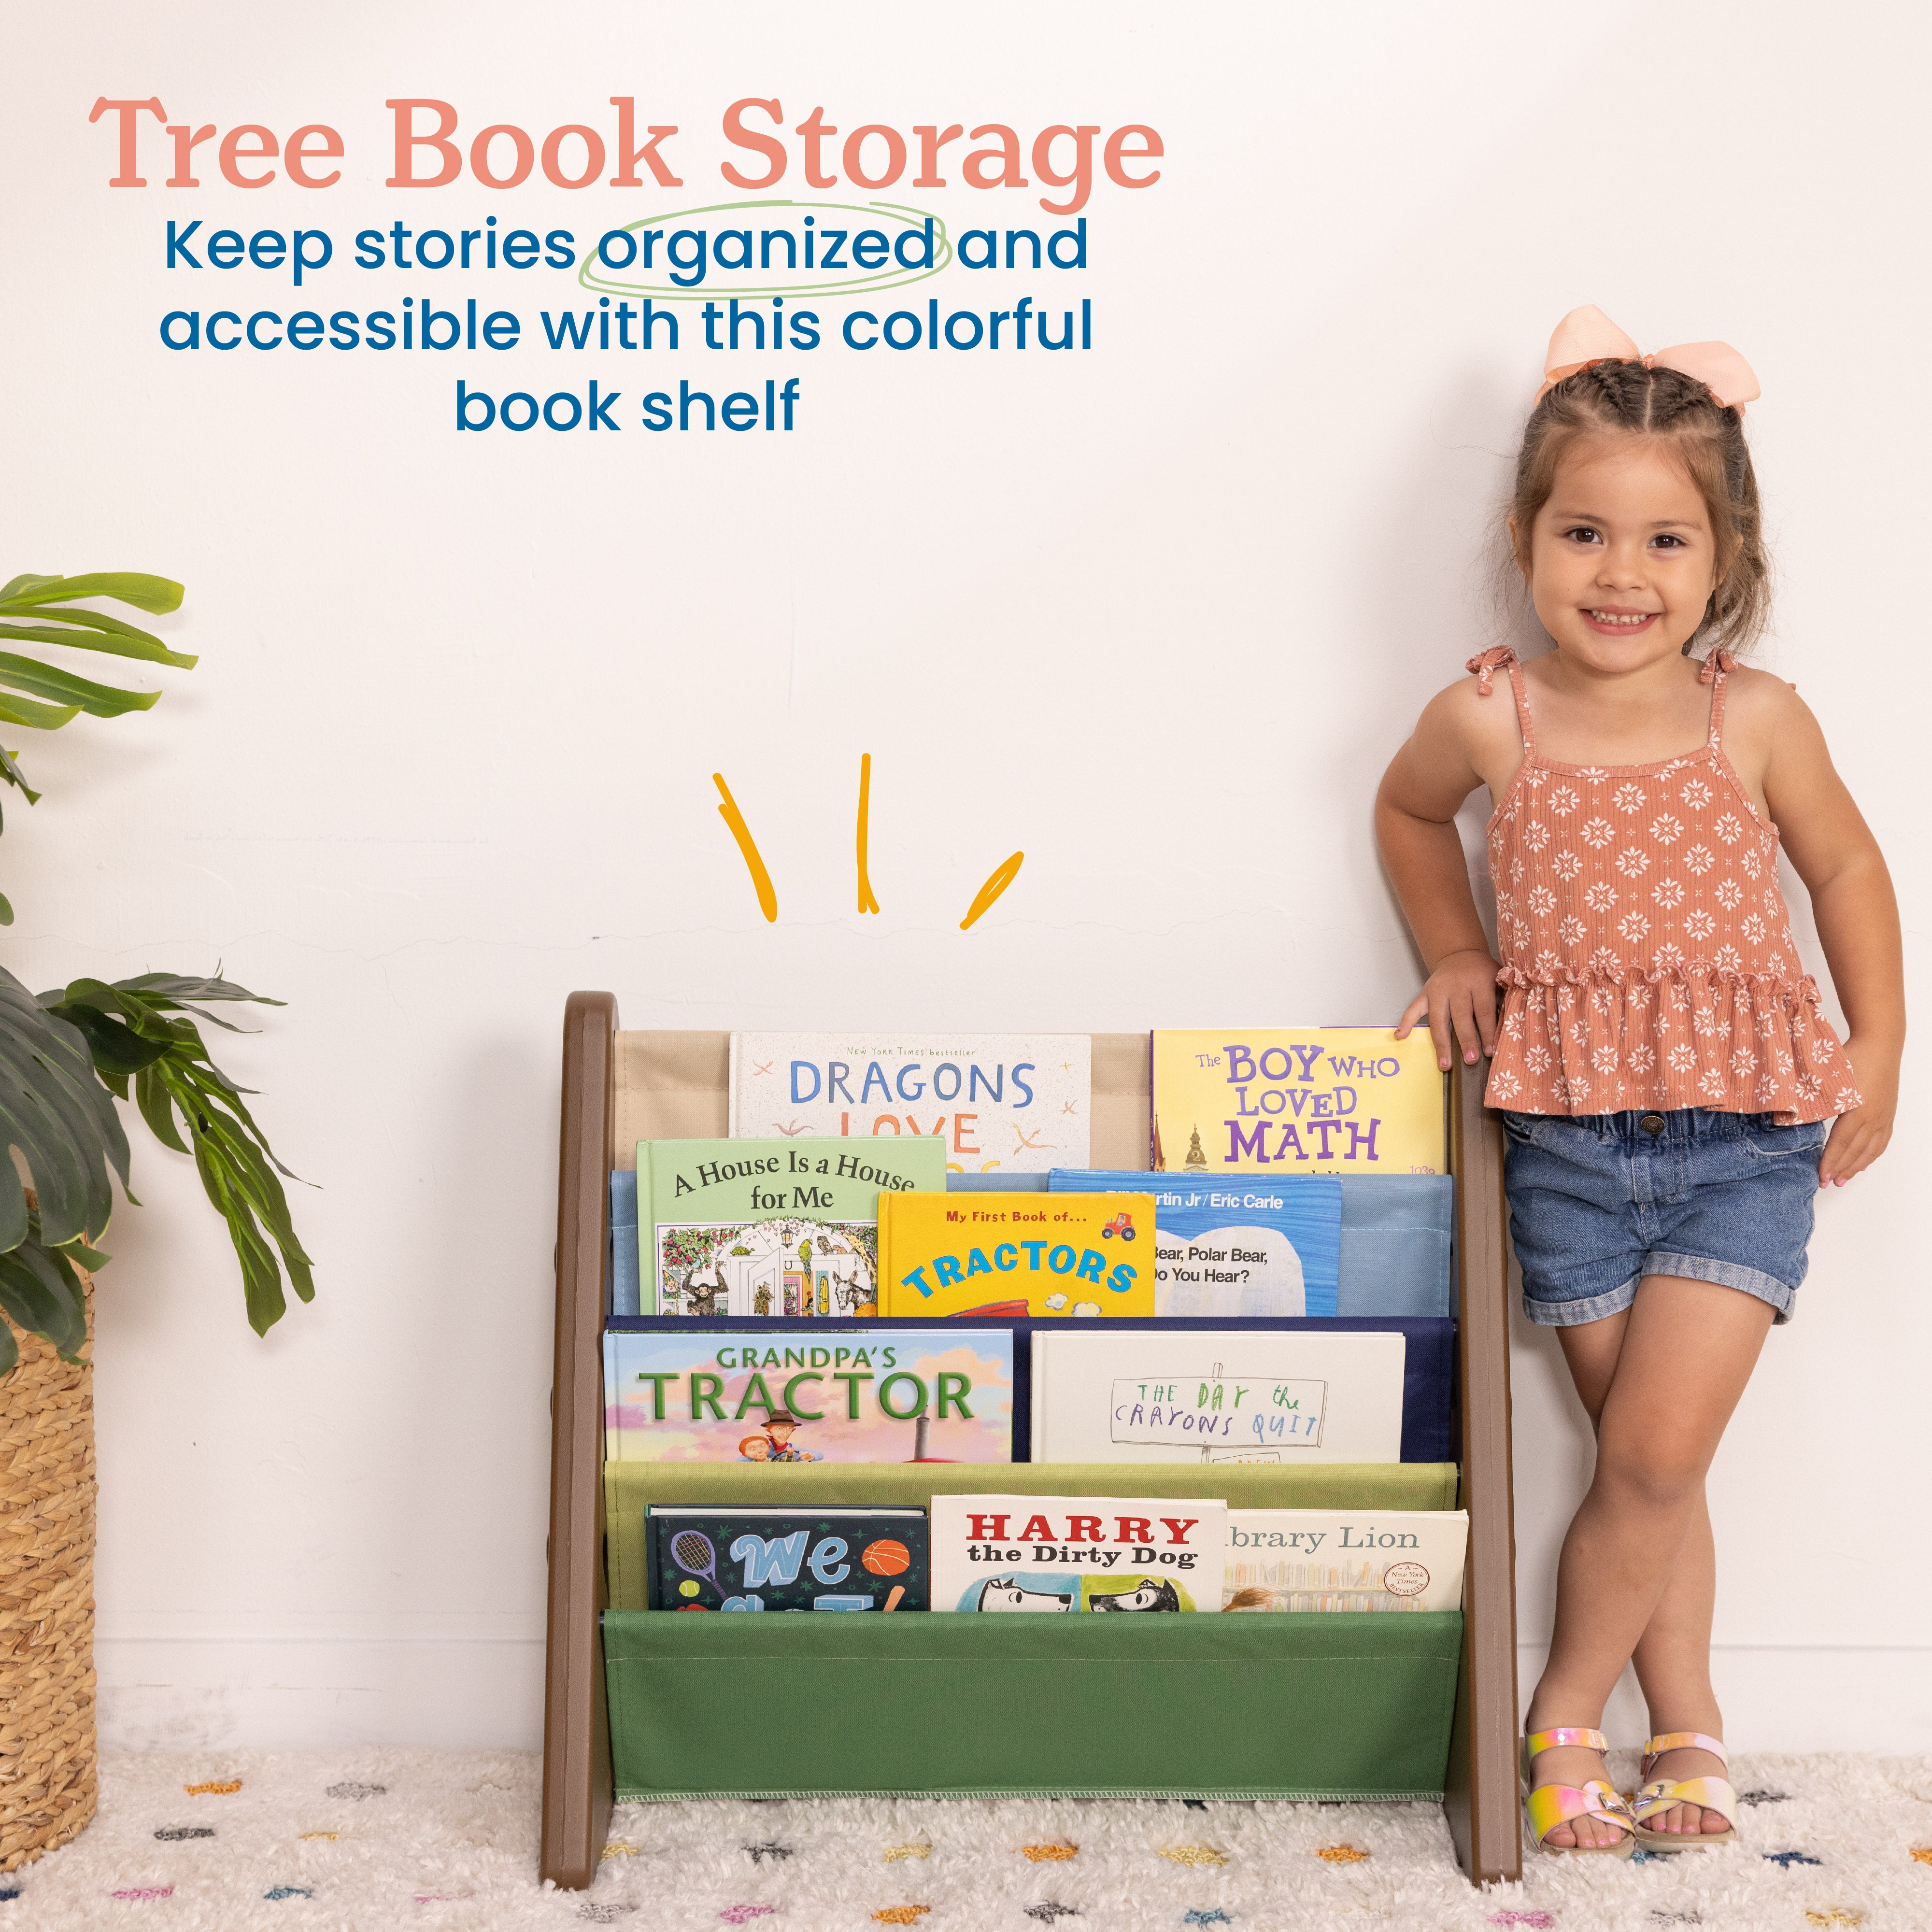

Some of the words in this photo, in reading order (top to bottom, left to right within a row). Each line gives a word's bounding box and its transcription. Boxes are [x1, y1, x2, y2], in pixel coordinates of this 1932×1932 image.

[1195, 1054, 1220, 1067] The
[1223, 1045, 1324, 1083] BOY
[1327, 1056, 1400, 1079] WHO
[791, 1061, 1035, 1108] DRAGONS
[1236, 1086, 1357, 1117] LOVED
[1224, 1119, 1381, 1163] MATH
[674, 1174, 696, 1197] A
[696, 1158, 780, 1186] House
[789, 1151, 809, 1172] Is
[816, 1159, 828, 1174] a
[835, 1154, 914, 1191] House
[751, 1186, 786, 1209] for
[792, 1187, 834, 1208] Me
[1156, 1192, 1181, 1206] rtin
[1185, 1193, 1202, 1206] Jr
[1211, 1193, 1240, 1208] Eric
[1244, 1194, 1283, 1209] Carle
[947, 1211, 966, 1223] My
[973, 1212, 1006, 1222] First
[1013, 1211, 1046, 1222] Book
[1054, 1212, 1086, 1222] of...
[901, 1241, 1137, 1298] TRACTORS
[1189, 1247, 1227, 1261] Polar
[1231, 1249, 1267, 1264] Bear,
[1155, 1268, 1167, 1280] o
[1172, 1268, 1199, 1281] You
[1205, 1269, 1249, 1283] Hear?
[717, 1347, 896, 1368] GRANDPA'S
[639, 1372, 974, 1420] TRACTOR
[1137, 1385, 1177, 1402] THE
[1197, 1383, 1249, 1411] DAY
[1273, 1385, 1298, 1409] the
[1116, 1404, 1233, 1435] CRAYONS
[1253, 1414, 1316, 1443] QUIT
[966, 1514, 1199, 1544] HARRY
[1230, 1526, 1326, 1554] brary
[1338, 1527, 1420, 1548] Lion
[967, 1545, 1021, 1561] the
[1033, 1546, 1122, 1567] Dirty
[1132, 1548, 1198, 1569] Dog
[1389, 1583, 1424, 1593] BESTSELLER
